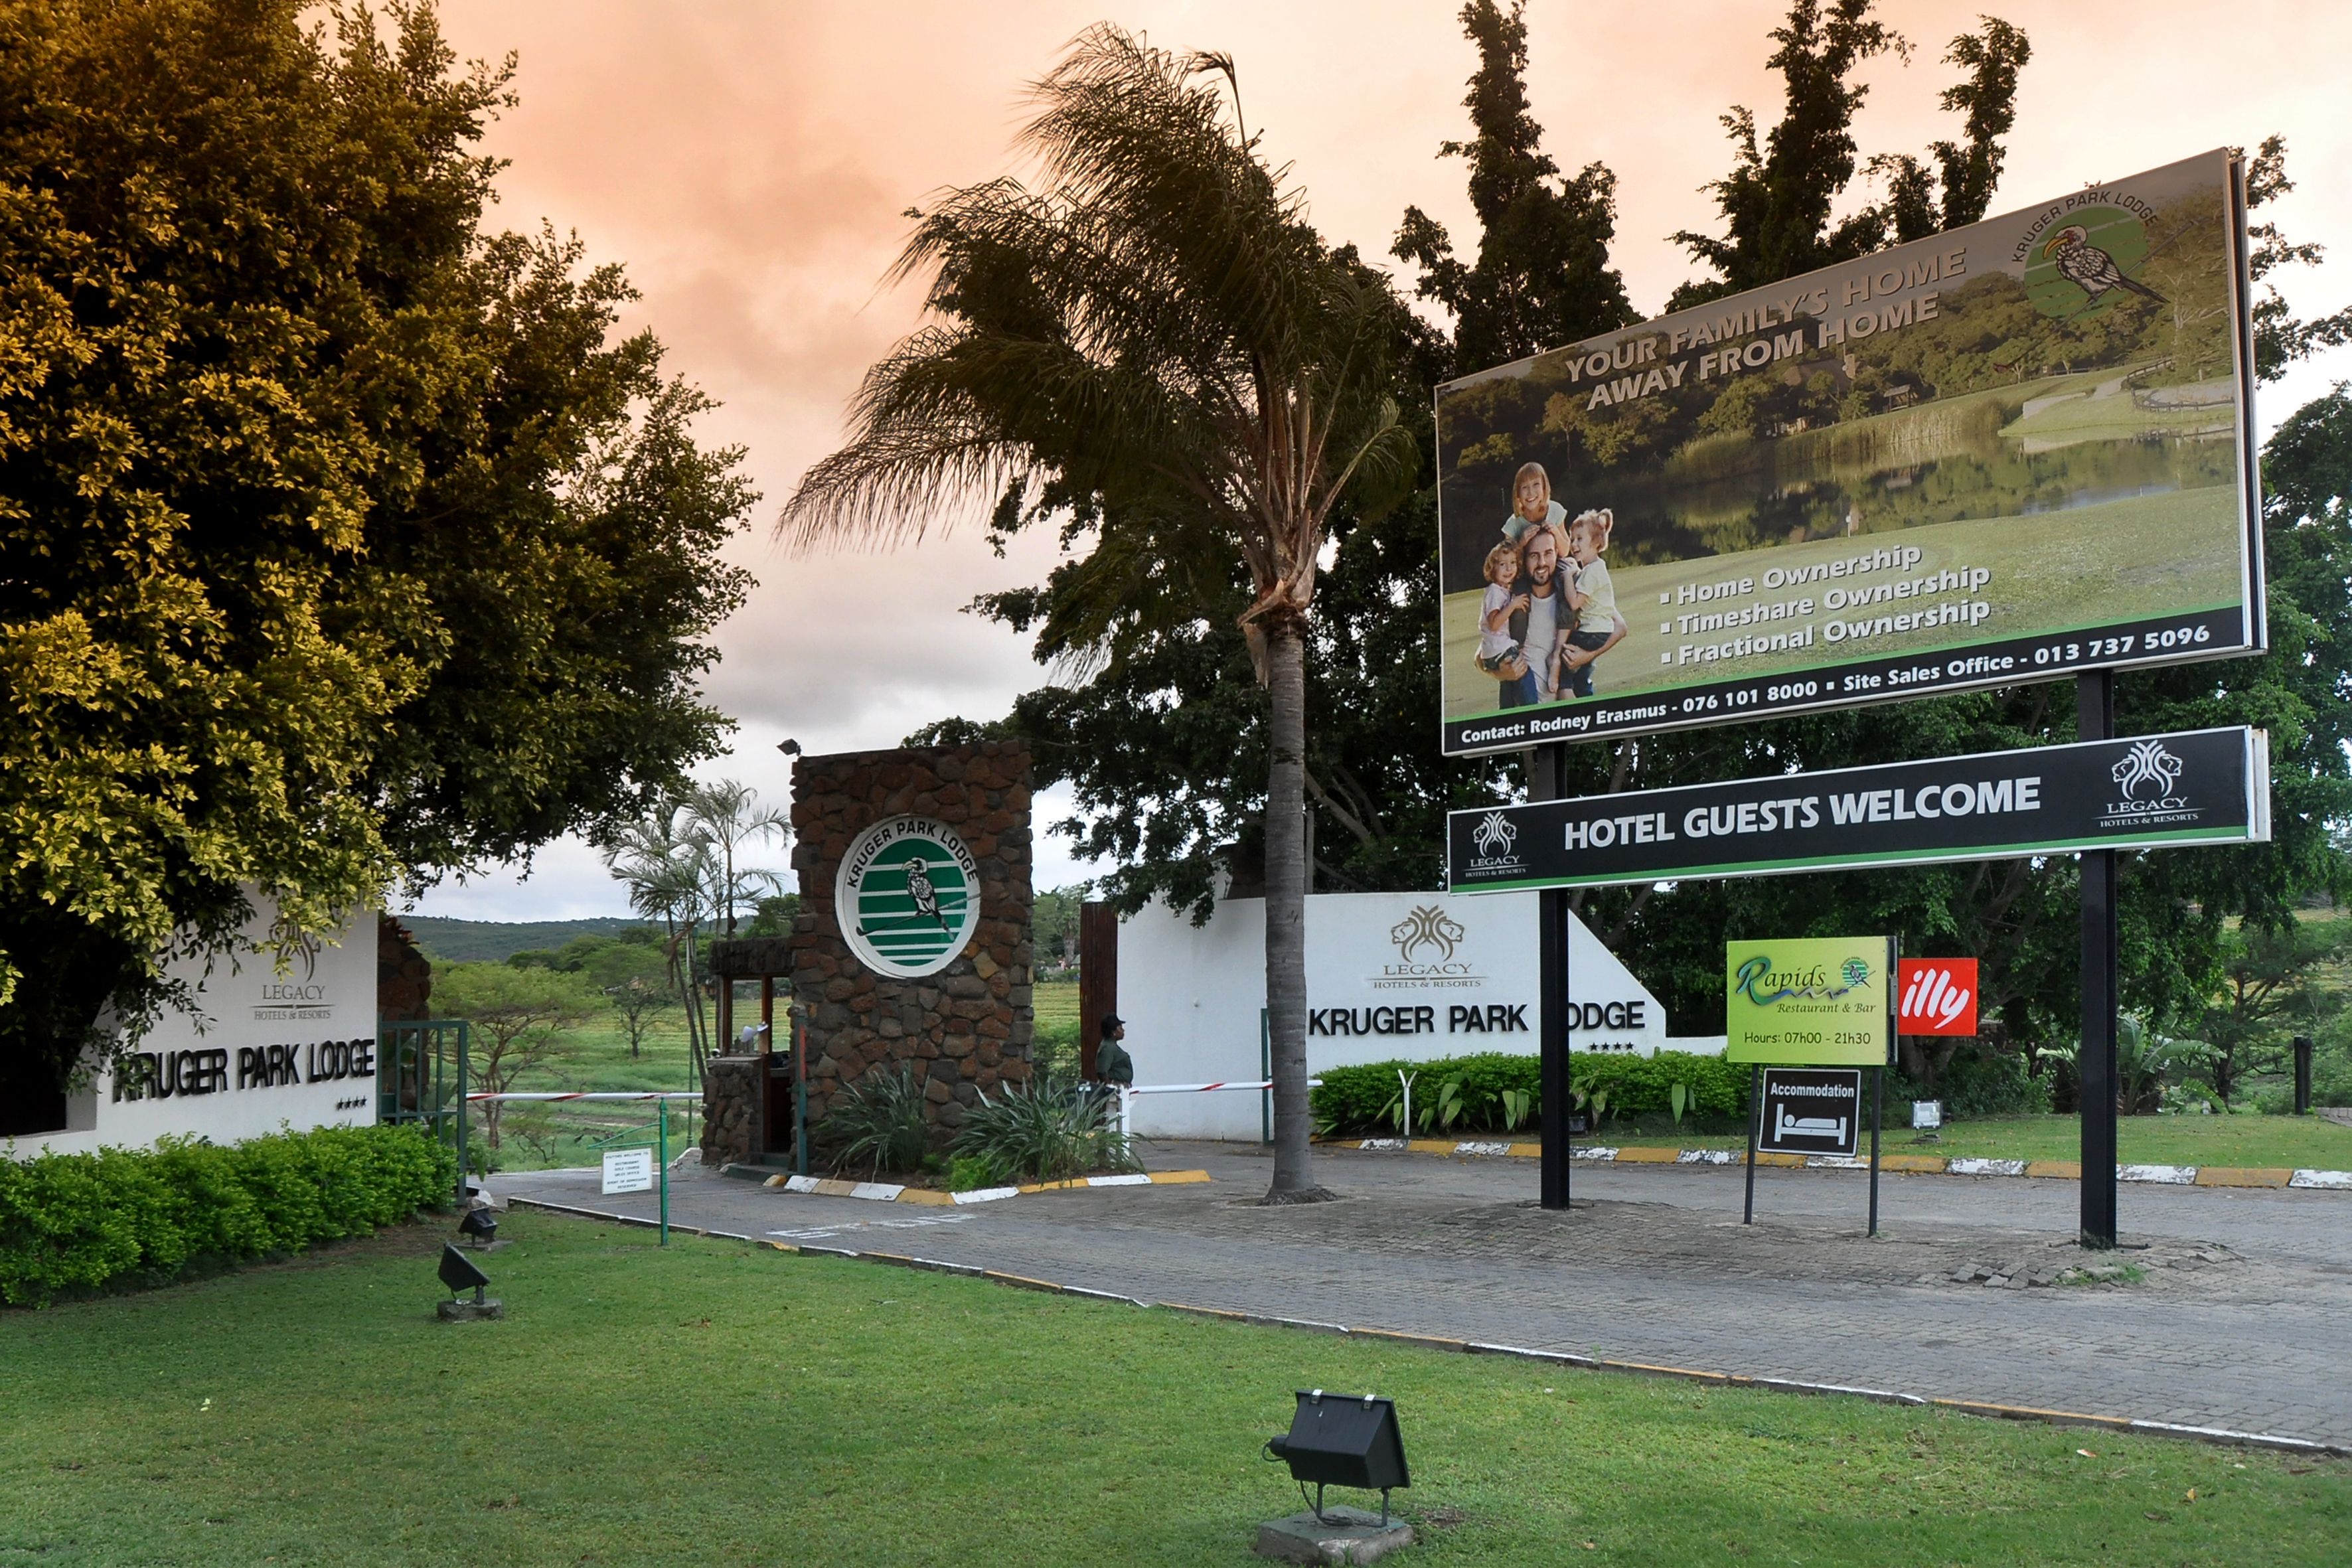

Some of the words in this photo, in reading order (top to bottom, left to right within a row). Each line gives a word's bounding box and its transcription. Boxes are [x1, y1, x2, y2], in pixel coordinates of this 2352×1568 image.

[2012, 206, 2061, 262] KRUGER
[2066, 191, 2110, 210] PARK
[2114, 193, 2158, 226] LODGE
[1565, 337, 1658, 383] YOUR
[1670, 288, 1830, 355] FAMILY'S
[1842, 246, 1967, 307] HOME
[1587, 360, 1688, 411] AWAY
[1699, 331, 1804, 381] FROM
[1818, 291, 1940, 349] HOME
[1678, 577, 1755, 605] Home
[1762, 545, 1922, 589] Ownership
[1678, 597, 1814, 635] Timeshare
[1824, 566, 1991, 610] Ownership
[1679, 625, 1814, 665] Fractional
[1824, 599, 1991, 643] Ownership
[1843, 672, 1881, 691] Site
[1888, 666, 1940, 686] Sales
[1948, 655, 2014, 676] Office
[2035, 645, 2080, 665] 013
[2088, 636, 2134, 657] 737
[2144, 625, 2211, 649] 5096
[1461, 722, 1525, 744] Contact:
[1529, 714, 1591, 735] Rodney
[1597, 704, 1667, 725] Erasmus
[1682, 694, 1719, 713] 076
[1726, 689, 1758, 706] 101
[1768, 681, 1818, 702] 8000
[1565, 812, 1676, 850] HOTEL
[1684, 796, 1820, 838] GUESTS
[1829, 777, 2041, 824] WELCOME
[2100, 818, 2139, 828] HOTELS
[2154, 813, 2199, 823] RESORTS
[2106, 797, 2188, 814] LEGACY
[847, 828, 892, 888] KRUGER
[897, 821, 937, 837] PARK
[940, 830, 979, 882] LODGE
[1470, 855, 1520, 868] LEGACY
[262, 984, 325, 1000] LEGACY
[1373, 979, 1417, 989] HOTELS
[1420, 979, 1430, 988] &
[1433, 978, 1482, 988] RESORTS
[1383, 963, 1472, 976] LEGACY
[1735, 956, 1826, 1006] Rapids
[254, 1010, 287, 1020] HOTELS
[298, 1010, 331, 1020] RESORTS
[1309, 1006, 1434, 1036] KRUGER
[1450, 1004, 1529, 1033] PARK
[1569, 1001, 1646, 1030] ODGE
[1777, 1003, 1838, 1014] Restaurant
[1842, 1004, 1851, 1014] &
[1854, 1003, 1877, 1014] Bar
[1901, 968, 1970, 1029] illy
[1744, 1032, 1781, 1044] Hours:
[1784, 1032, 1822, 1044] 07h00
[1834, 1032, 1871, 1045] 21h30
[238, 1044, 301, 1090] PARK
[307, 1039, 375, 1083] LODGE
[1770, 1082, 1854, 1098] Accommodation
